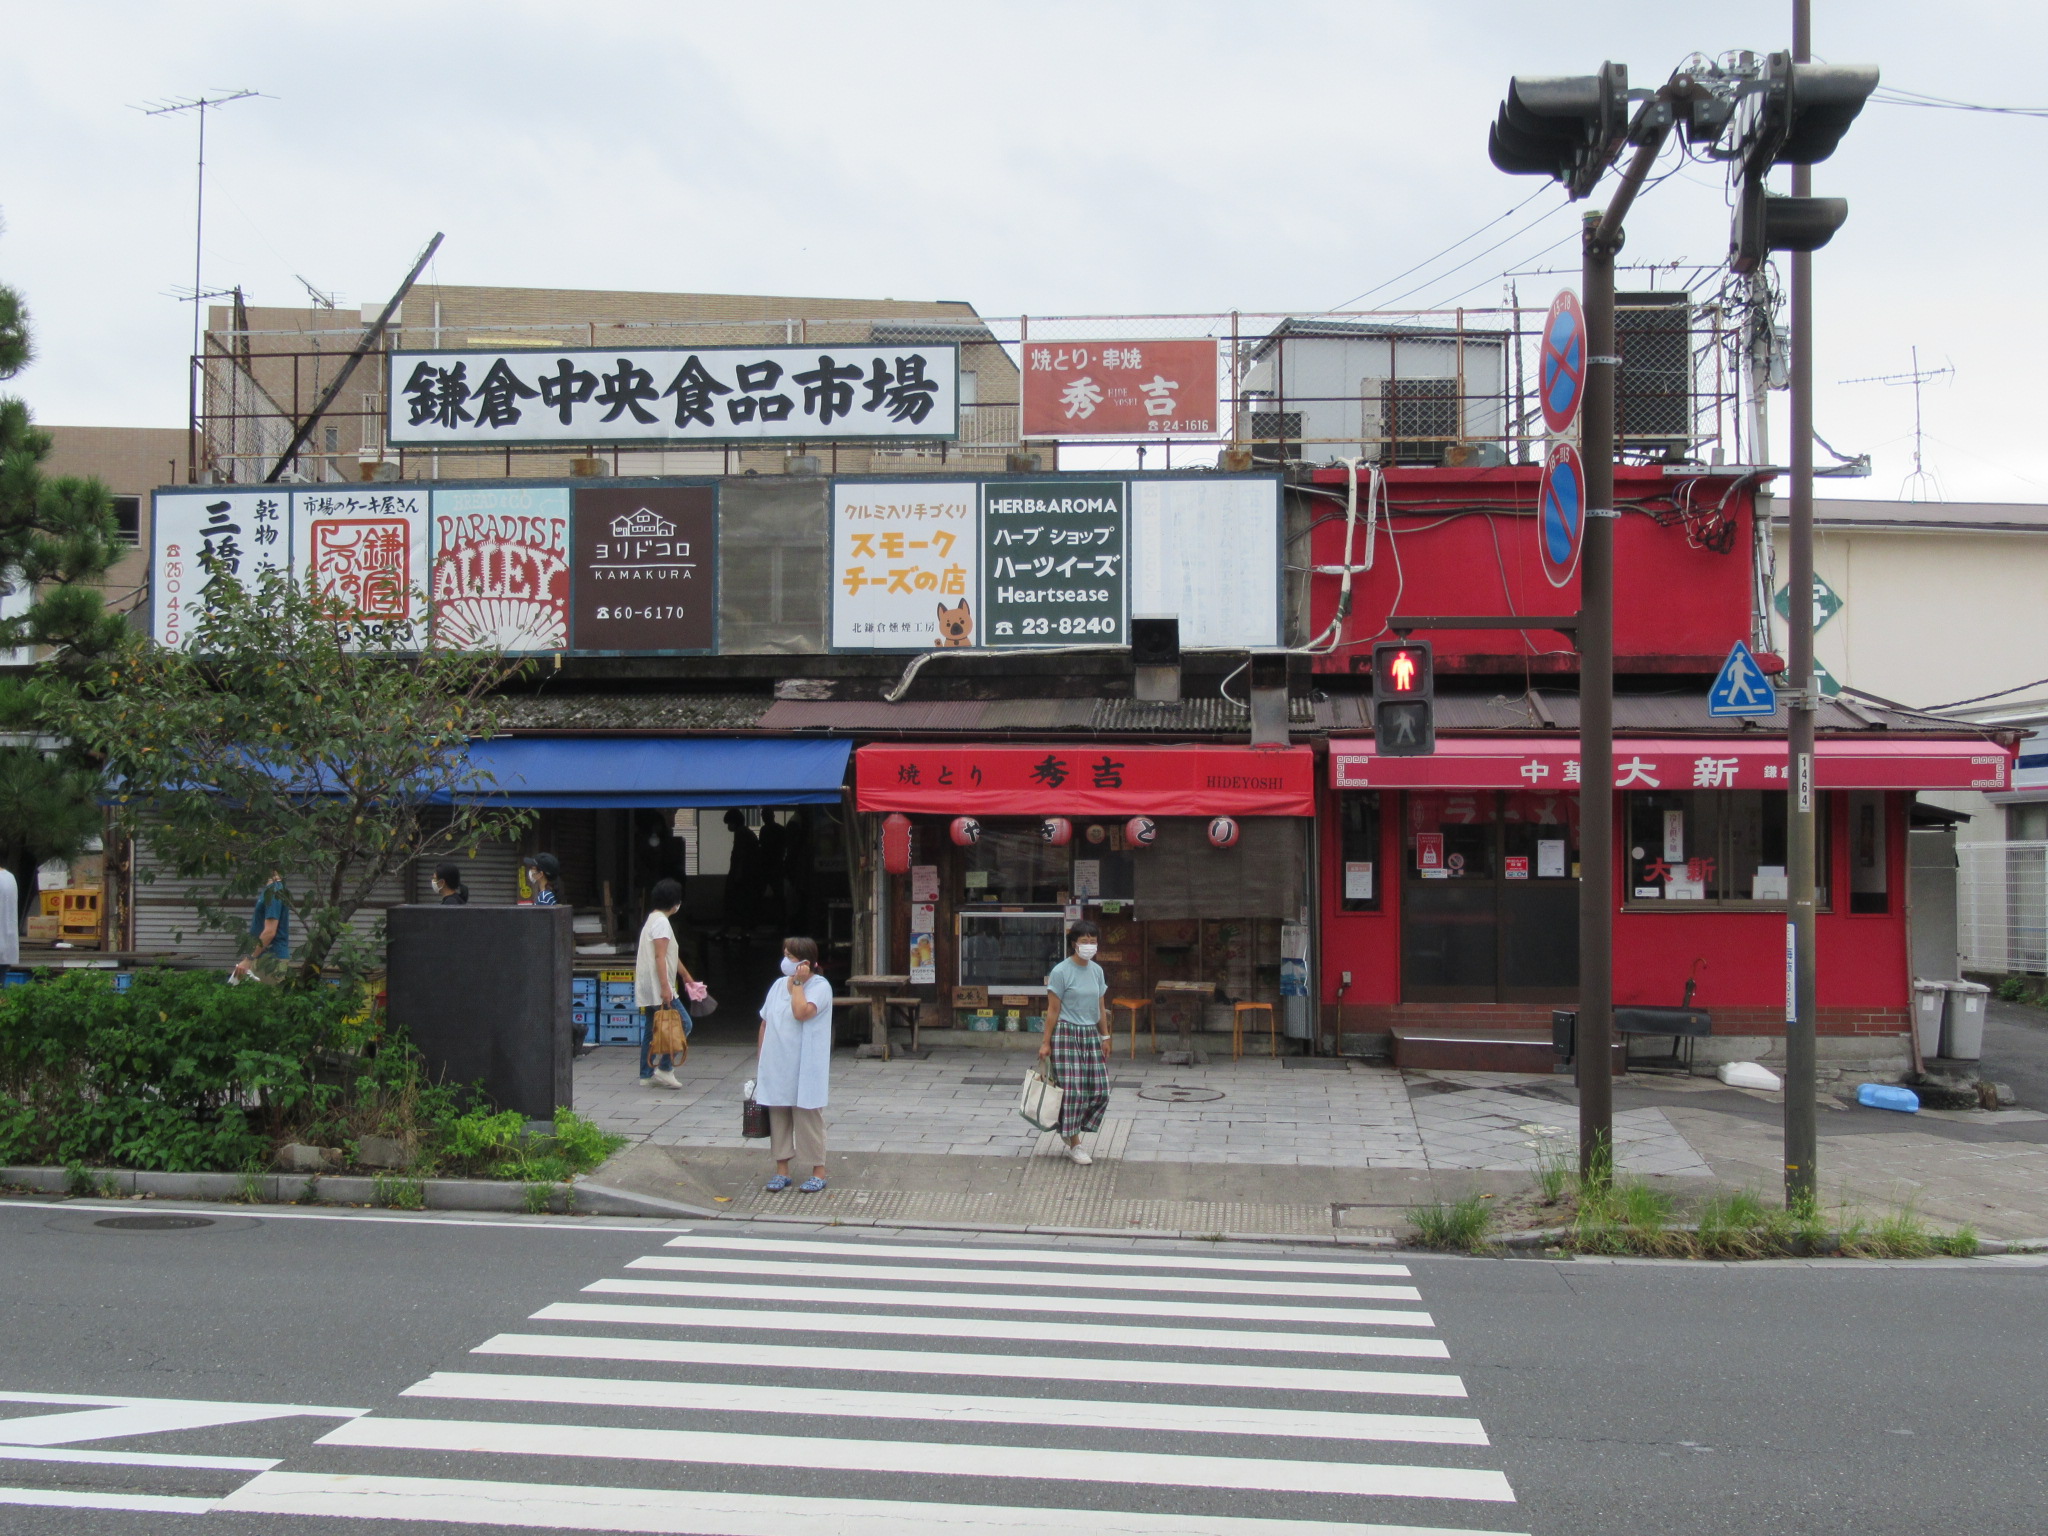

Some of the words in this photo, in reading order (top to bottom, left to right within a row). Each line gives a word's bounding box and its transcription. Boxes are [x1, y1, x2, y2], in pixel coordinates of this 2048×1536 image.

[1553, 294, 1571, 318] 13-18
[1031, 348, 1142, 371] 焼とり・串焼
[401, 353, 940, 428] 鎌倉中央食品市場
[1059, 374, 1179, 420] 秀吉
[303, 496, 419, 516] 市場のケーキ屋さん
[845, 503, 967, 520] クルミ入り手づくり
[989, 499, 1117, 514] HERB&AROMA
[437, 513, 566, 552] PARADISE
[851, 530, 957, 558] スモーク
[993, 526, 1044, 545] ハーブ
[1049, 525, 1115, 545] ショップ
[596, 540, 690, 559] ヨリドコロ
[433, 546, 568, 600] ALLEY
[595, 570, 692, 580] KAMAKURA
[993, 554, 1121, 578] ハーツイーズ
[843, 563, 967, 596] チーズの店
[997, 586, 1109, 603] Heartsease
[614, 606, 684, 619] 60-6170
[1022, 617, 1116, 634] 23-8240
[897, 763, 983, 787] 焼とり
[1029, 755, 1125, 789] 秀吉
[1206, 775, 1284, 789] HIDEYOSHI
[1615, 756, 1739, 788] 大新
[1135, 820, 1157, 844] と
[1211, 819, 1234, 843] り
[1643, 857, 1716, 882] 大新
